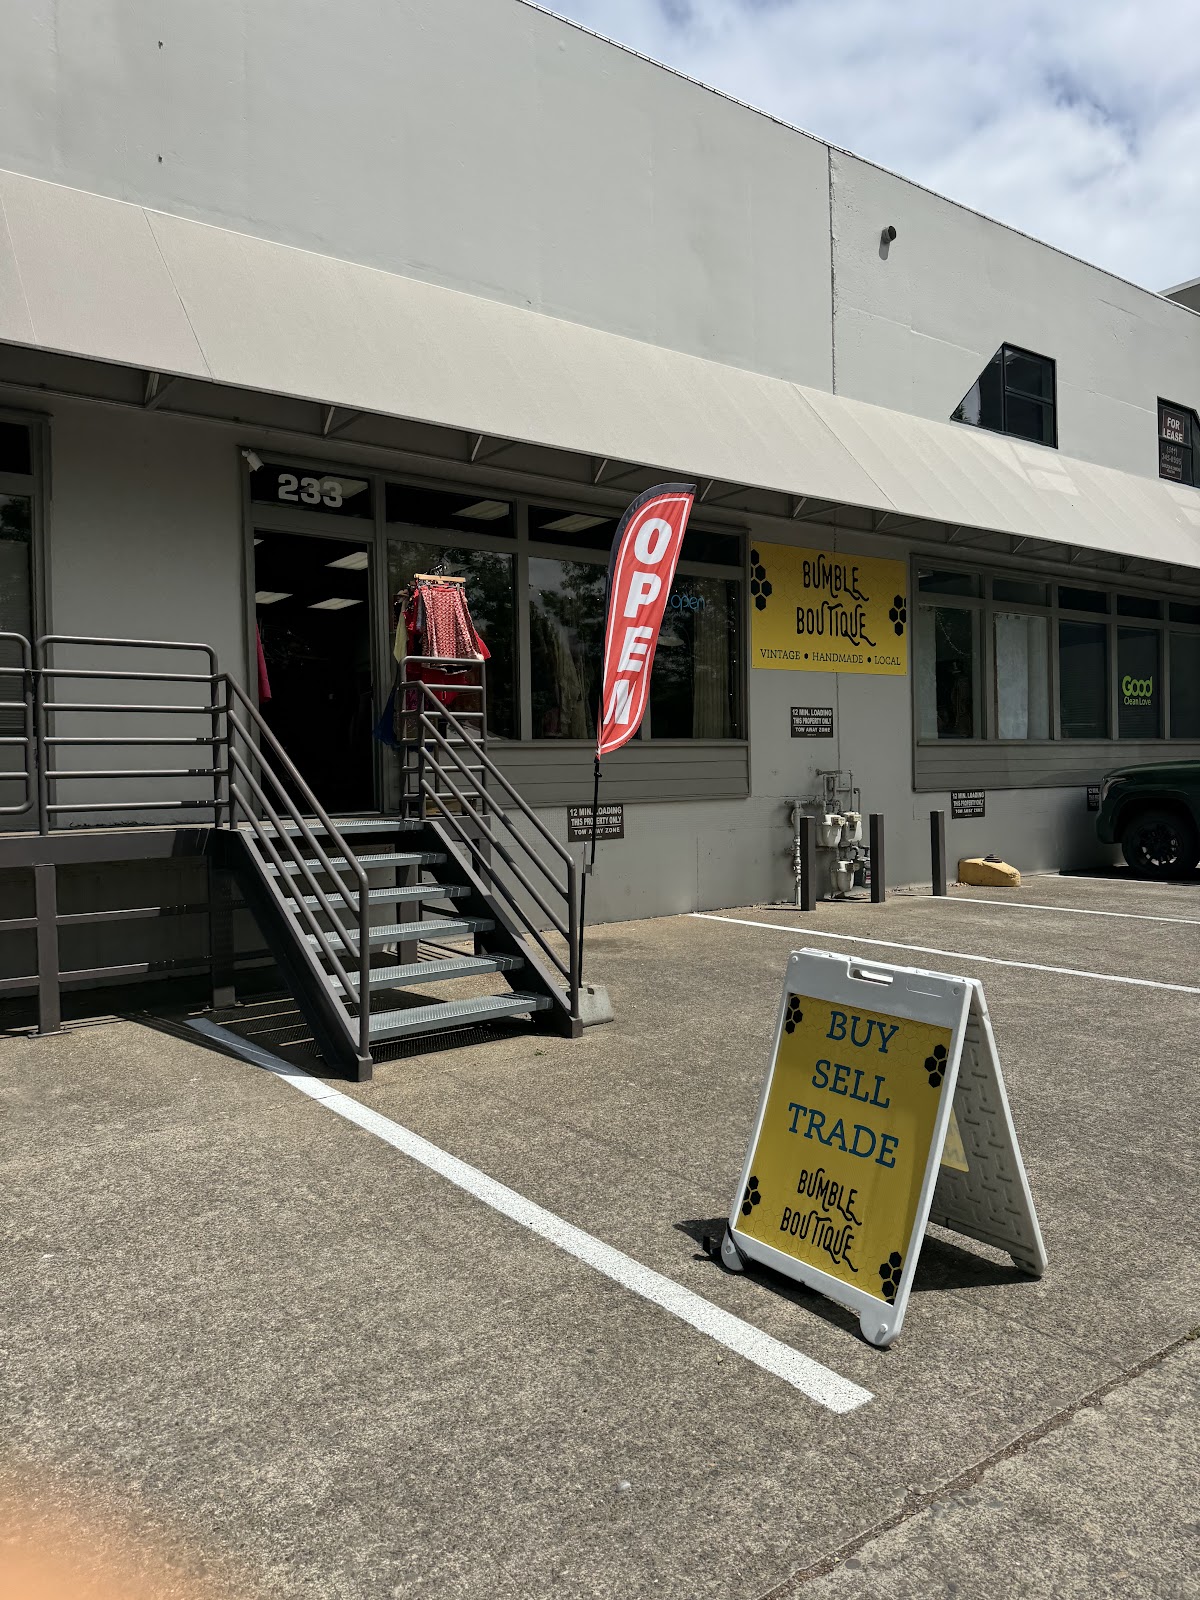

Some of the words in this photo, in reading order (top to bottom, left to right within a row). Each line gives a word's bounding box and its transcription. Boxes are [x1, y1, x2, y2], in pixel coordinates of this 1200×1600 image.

[1162, 427, 1184, 443] LEASE
[1167, 416, 1180, 431] FOR
[278, 473, 343, 508] 233
[802, 554, 870, 602] BUMBLE
[603, 517, 673, 725] OPEN
[796, 600, 877, 647] BOUTIQUE
[760, 648, 801, 661] VINTAGE
[812, 651, 864, 665] HANDMADE
[874, 655, 901, 667] LOCAL
[1122, 675, 1153, 697] Good
[1139, 697, 1152, 706] Love
[792, 708, 798, 716] 12
[570, 808, 578, 816] 12
[578, 808, 593, 816] MIN.
[596, 806, 622, 815] OADING
[571, 818, 583, 826] THIS
[583, 816, 608, 825] PROERTY
[609, 816, 622, 824] ONLY
[826, 1010, 900, 1054] BUY
[811, 1059, 891, 1109] SELL
[788, 1102, 900, 1170] TRADE
[797, 1168, 862, 1226] BUMBLE
[780, 1206, 859, 1272] BOUTIQUE
